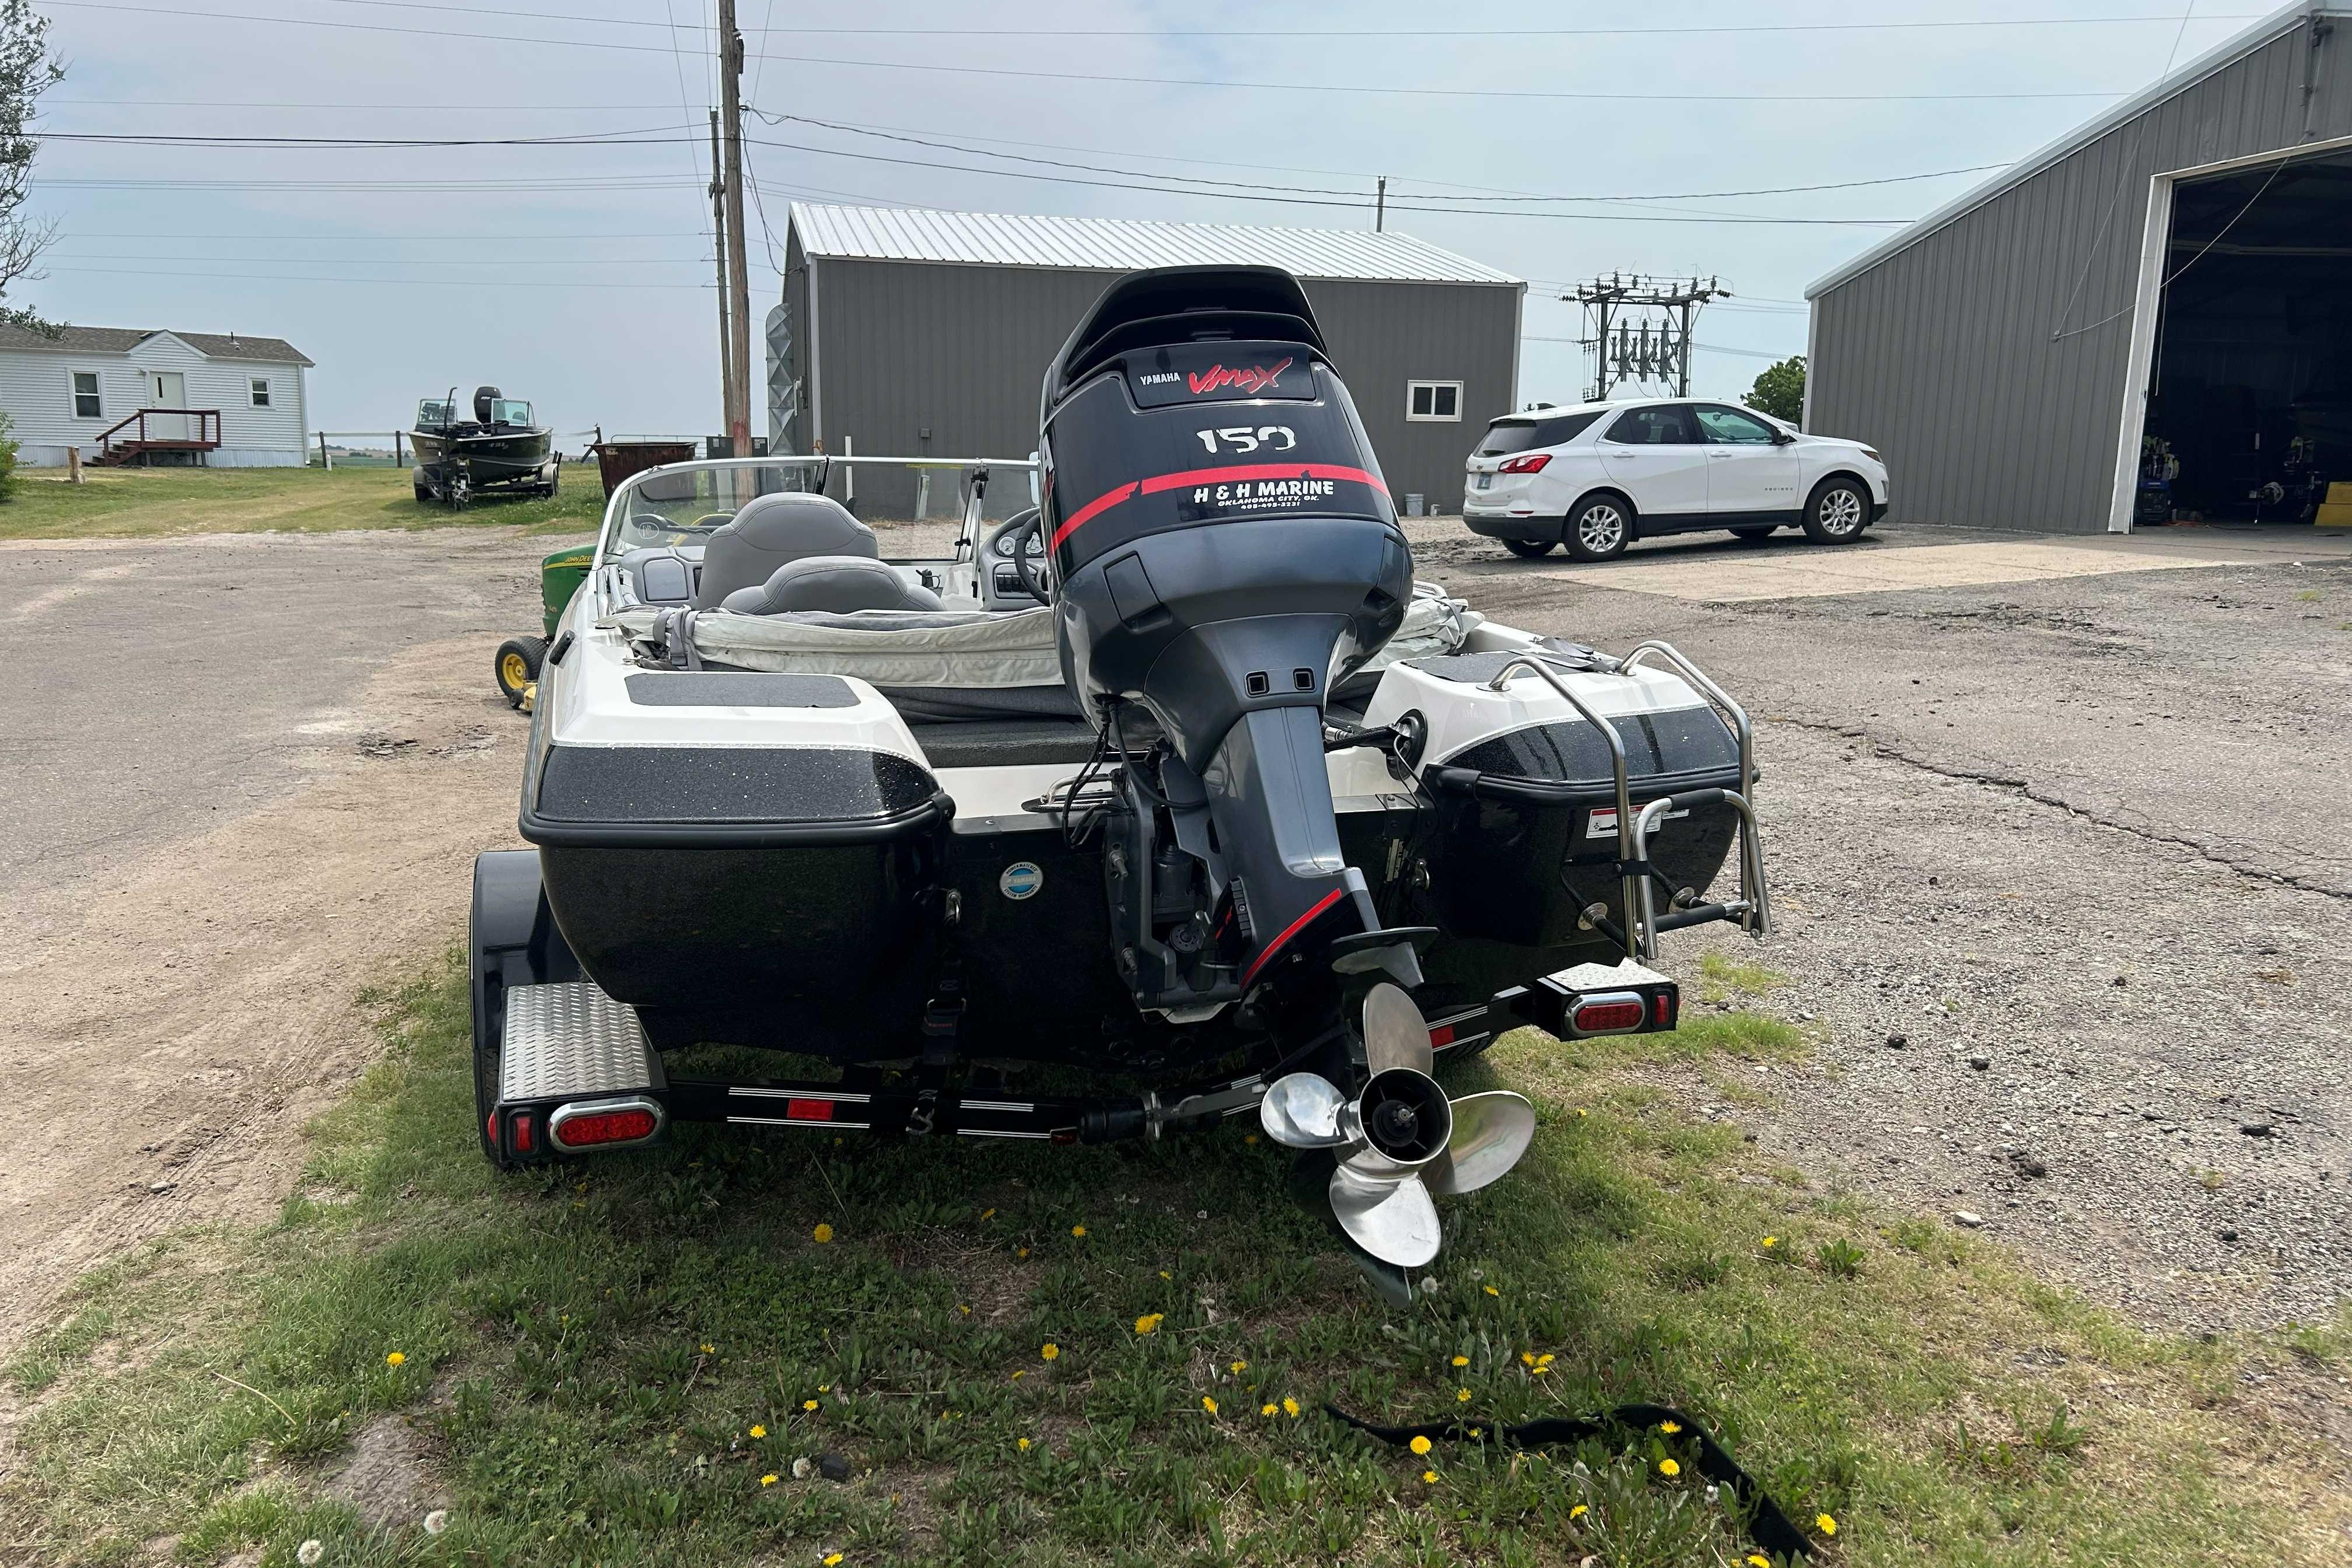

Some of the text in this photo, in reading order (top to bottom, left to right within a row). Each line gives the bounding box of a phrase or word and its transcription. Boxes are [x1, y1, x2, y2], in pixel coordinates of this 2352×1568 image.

[1140, 372, 1181, 386] YAMAHA
[1196, 425, 1296, 453] 150
[1194, 481, 1334, 503] H & H MARINE
[1217, 496, 1275, 507] OKLAHOMA
[1013, 875, 1037, 883] YAMAHA
